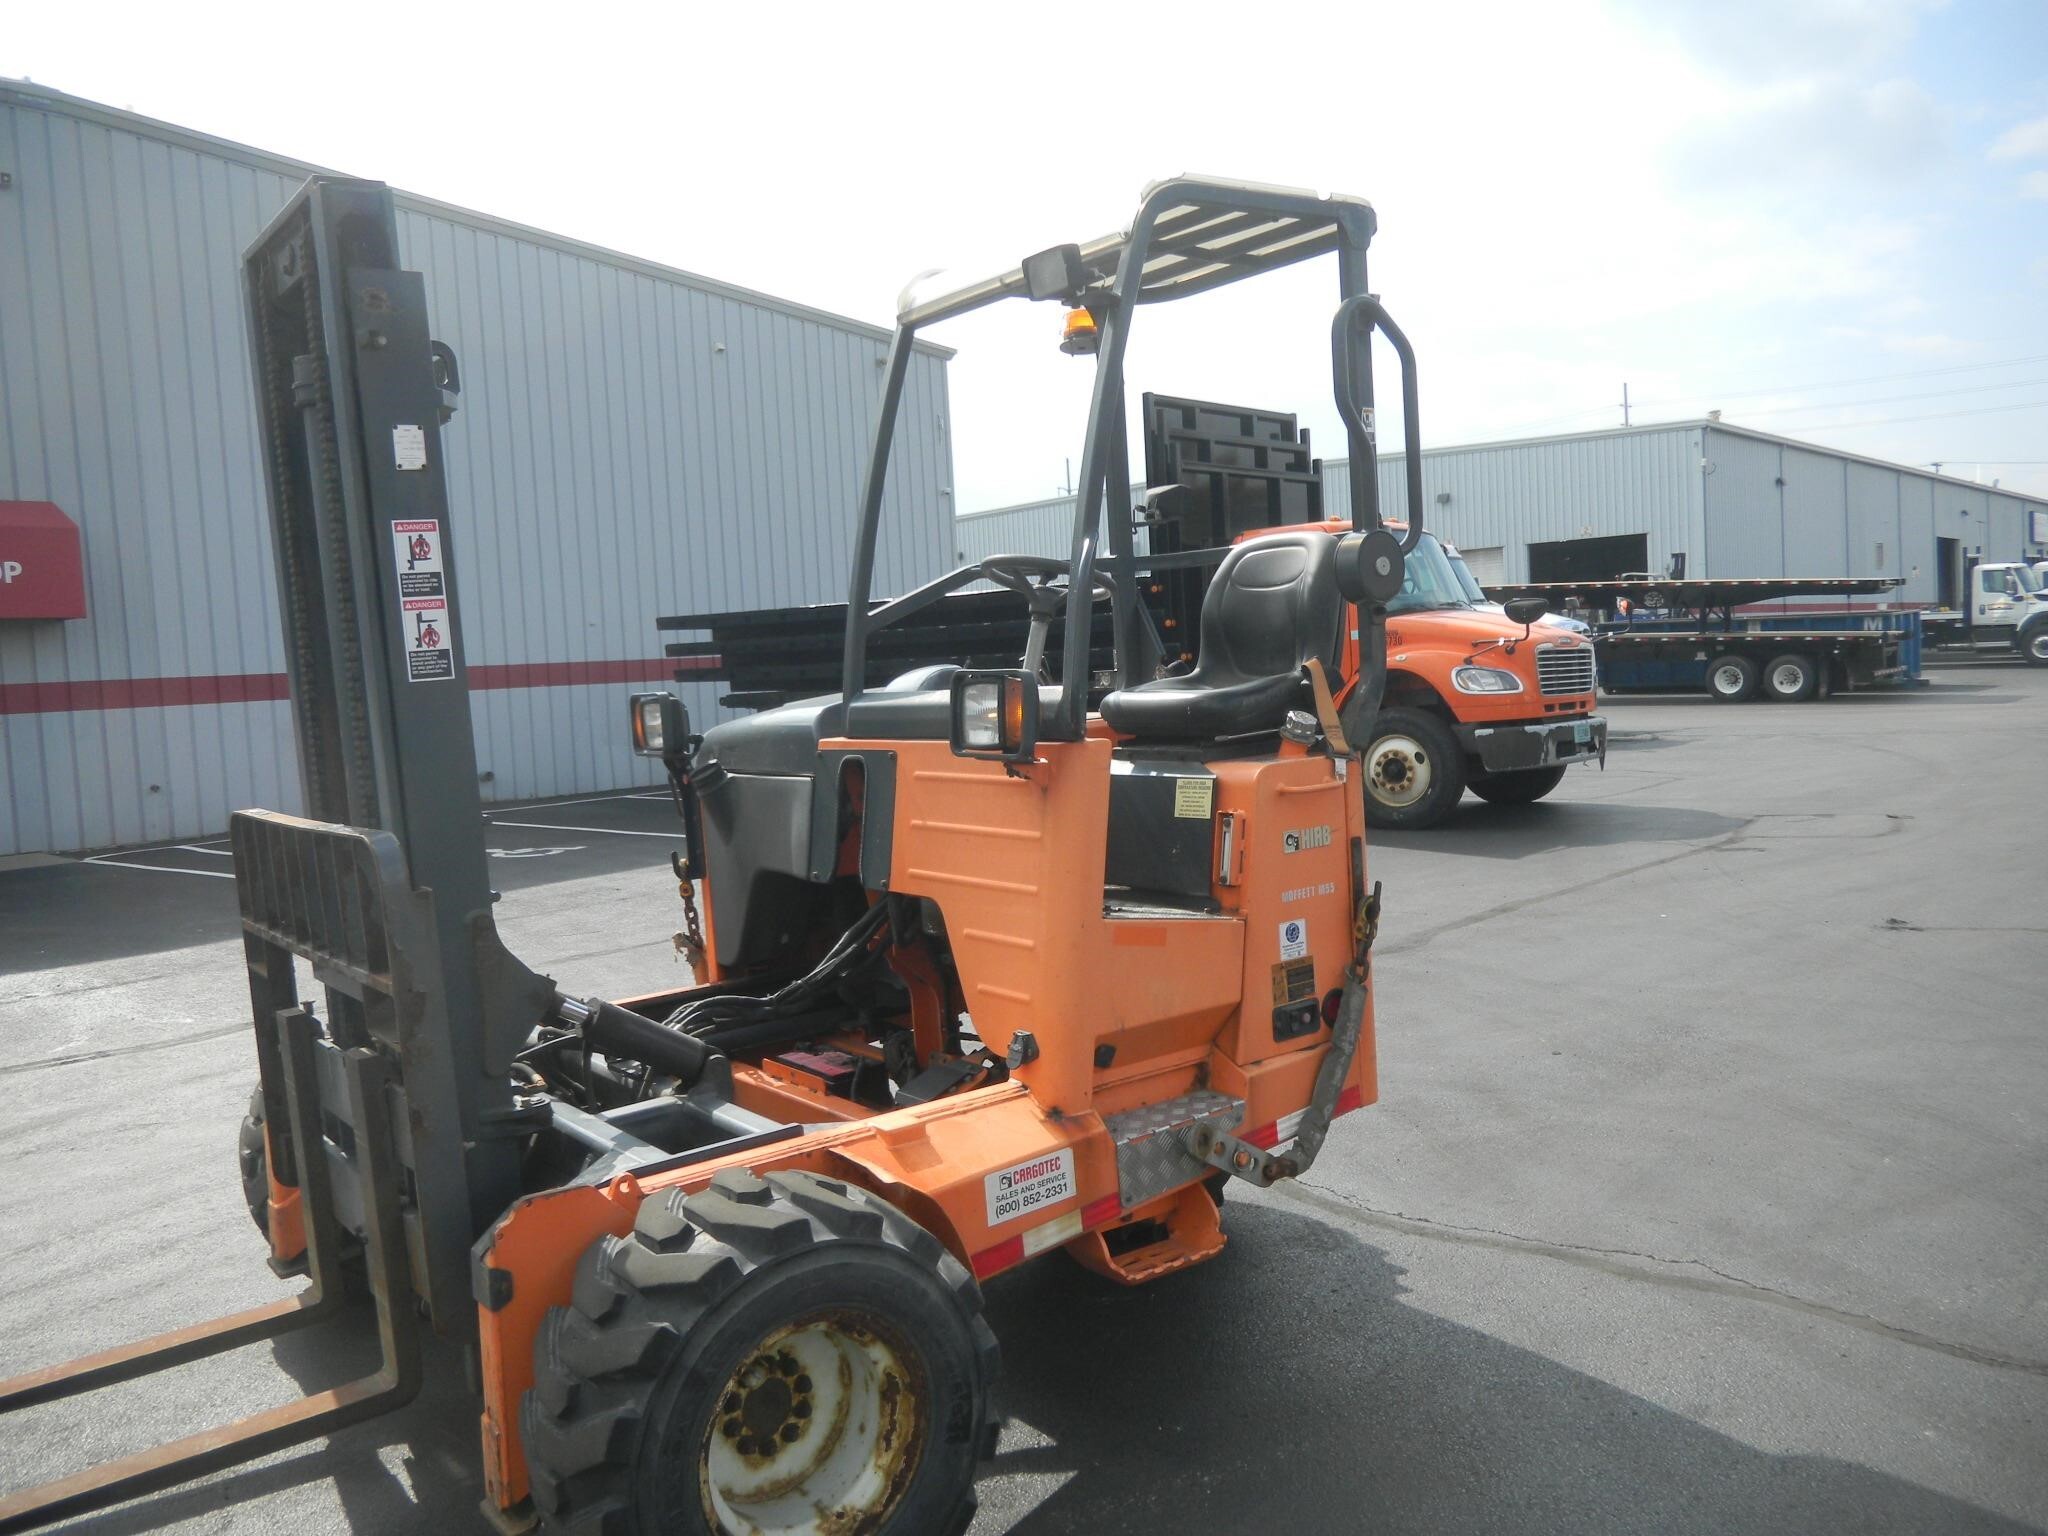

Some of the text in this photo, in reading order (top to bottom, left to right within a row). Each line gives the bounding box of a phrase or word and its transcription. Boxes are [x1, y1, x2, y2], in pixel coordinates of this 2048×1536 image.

[403, 523, 434, 531] DANGER
[0, 561, 22, 584] P
[412, 601, 442, 610] DANGER
[1301, 825, 1330, 849] HIAB
[1281, 886, 1316, 903] MOFFETT
[1013, 1156, 1062, 1185] CARGOTEC
[995, 1172, 1067, 1203] SALES AND SERVICE
[995, 1182, 1068, 1219] (800) 852-2331
